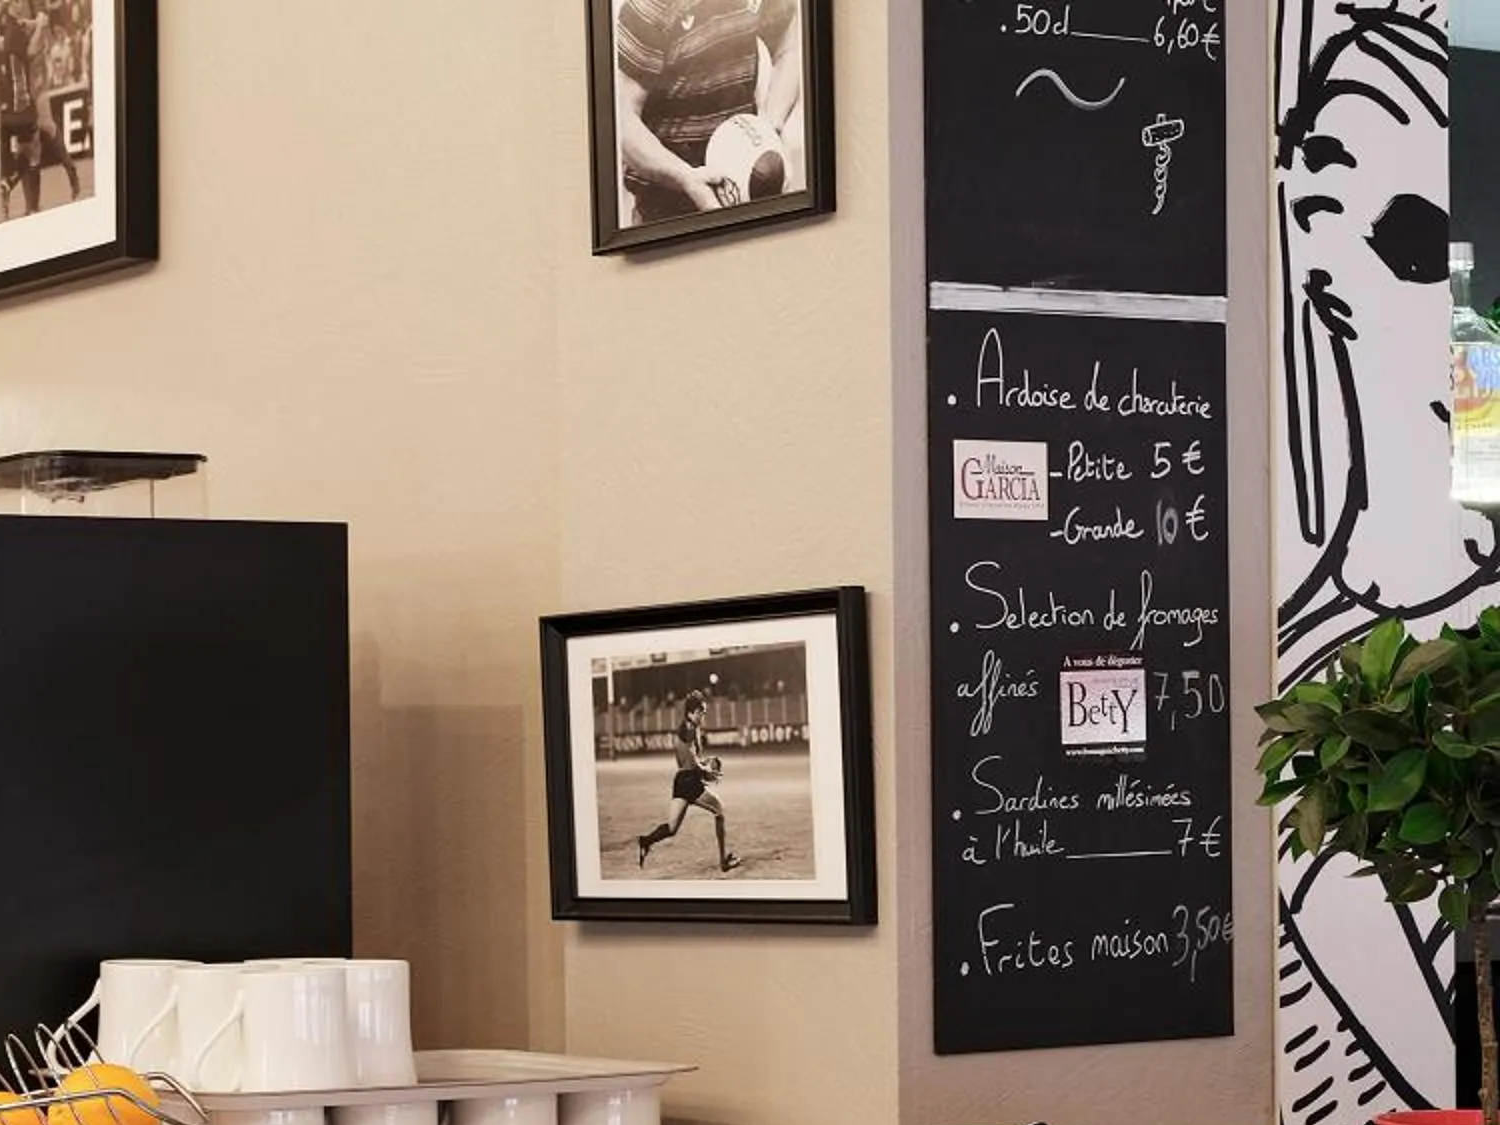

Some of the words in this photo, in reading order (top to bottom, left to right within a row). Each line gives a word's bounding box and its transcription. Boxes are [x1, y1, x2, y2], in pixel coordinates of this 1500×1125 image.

[63, 99, 90, 152] E
[976, 328, 1076, 409] Ardoise
[1083, 361, 1109, 412] de
[961, 457, 1041, 500] GARCIA
[965, 561, 1094, 629] Selection
[1104, 589, 1127, 631] de
[1130, 569, 1219, 651] fromages
[957, 650, 1040, 737] affinés
[1153, 670, 1225, 731] 7,50
[972, 755, 1080, 815] Sardines
[978, 903, 1074, 976] Frites
[1091, 919, 1169, 961] maison
